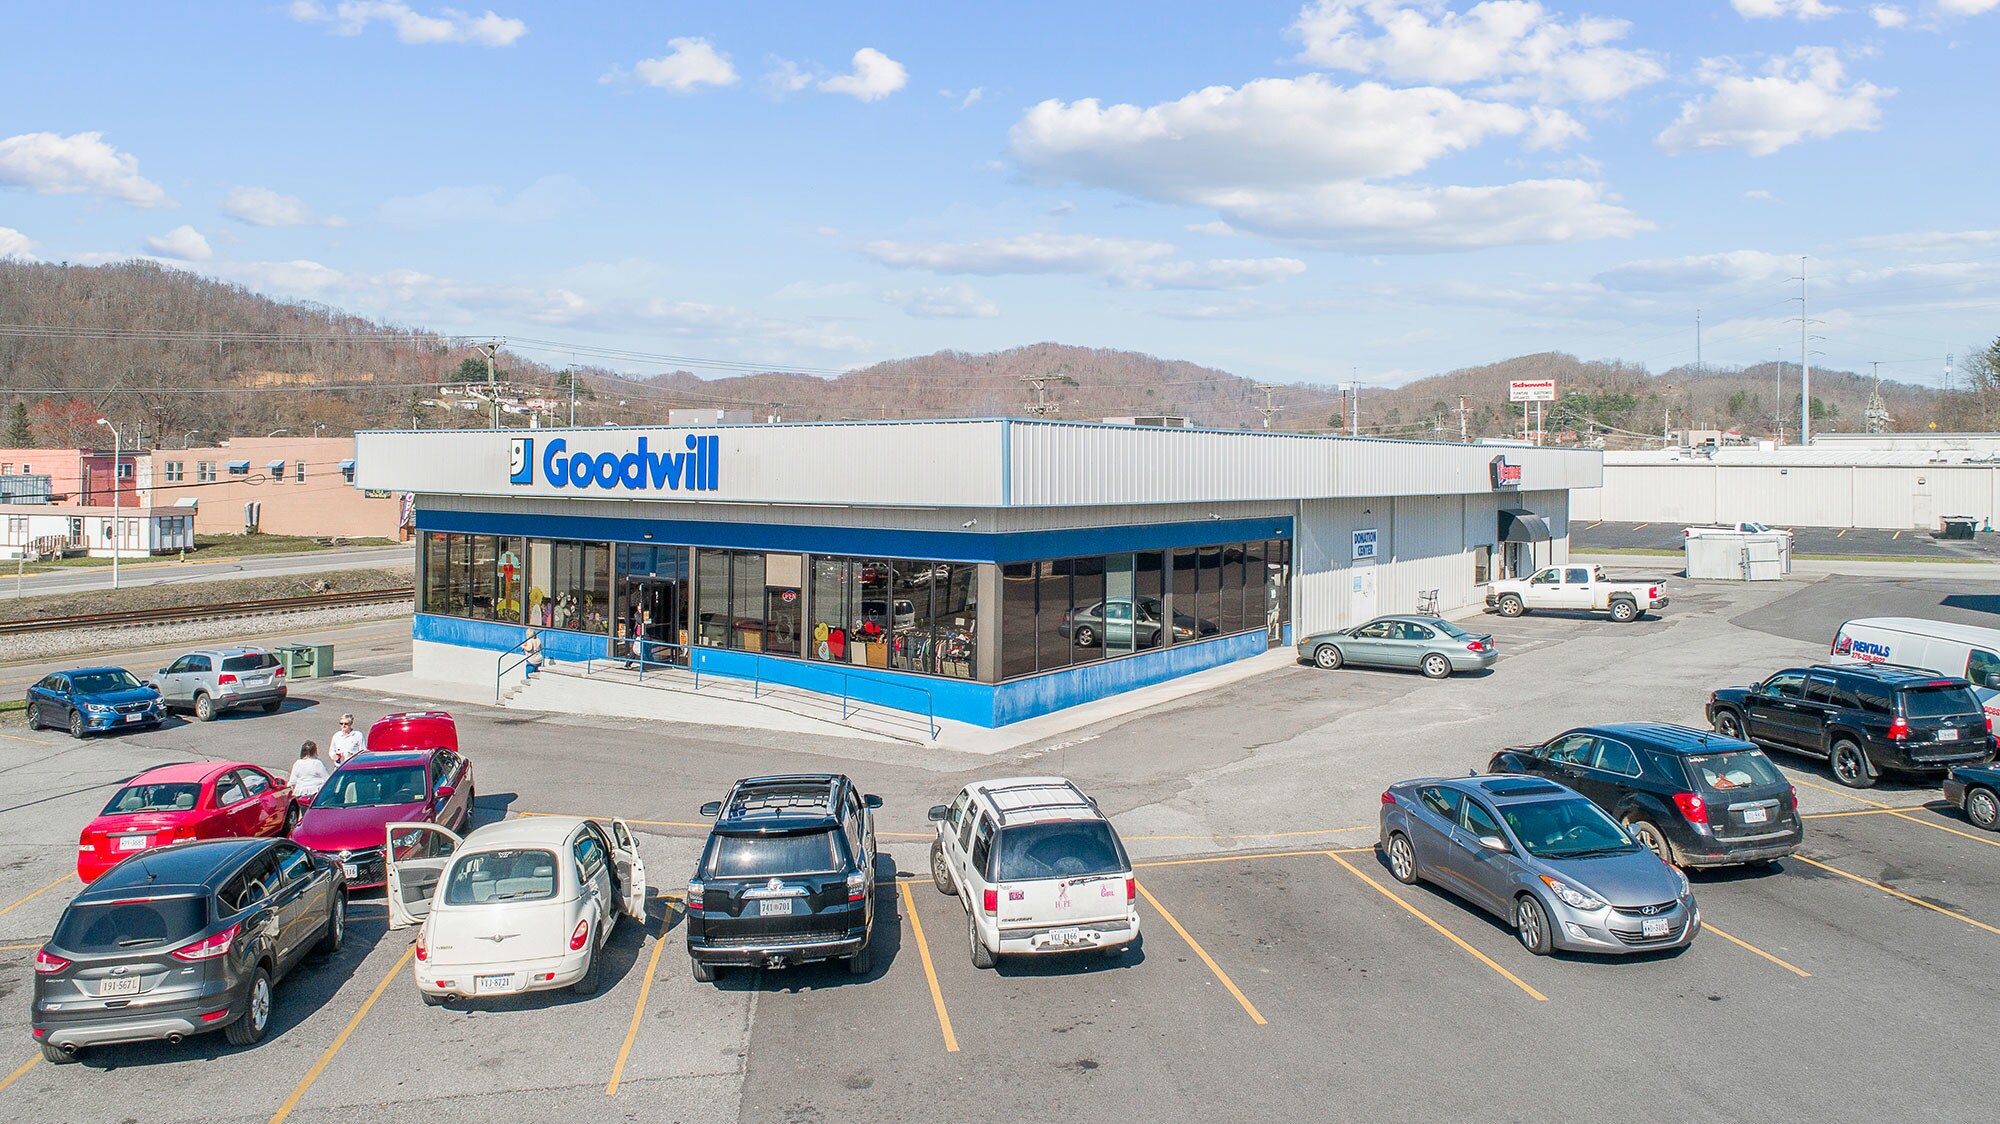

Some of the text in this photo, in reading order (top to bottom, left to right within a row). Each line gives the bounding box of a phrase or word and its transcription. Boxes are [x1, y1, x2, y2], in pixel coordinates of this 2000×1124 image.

[543, 433, 719, 492] Goodwill
[1354, 531, 1377, 544] DONATION
[1357, 544, 1374, 556] CENTER
[782, 591, 797, 601] OPEN
[1852, 640, 1891, 657] RENTALS
[762, 902, 790, 912] 741 701
